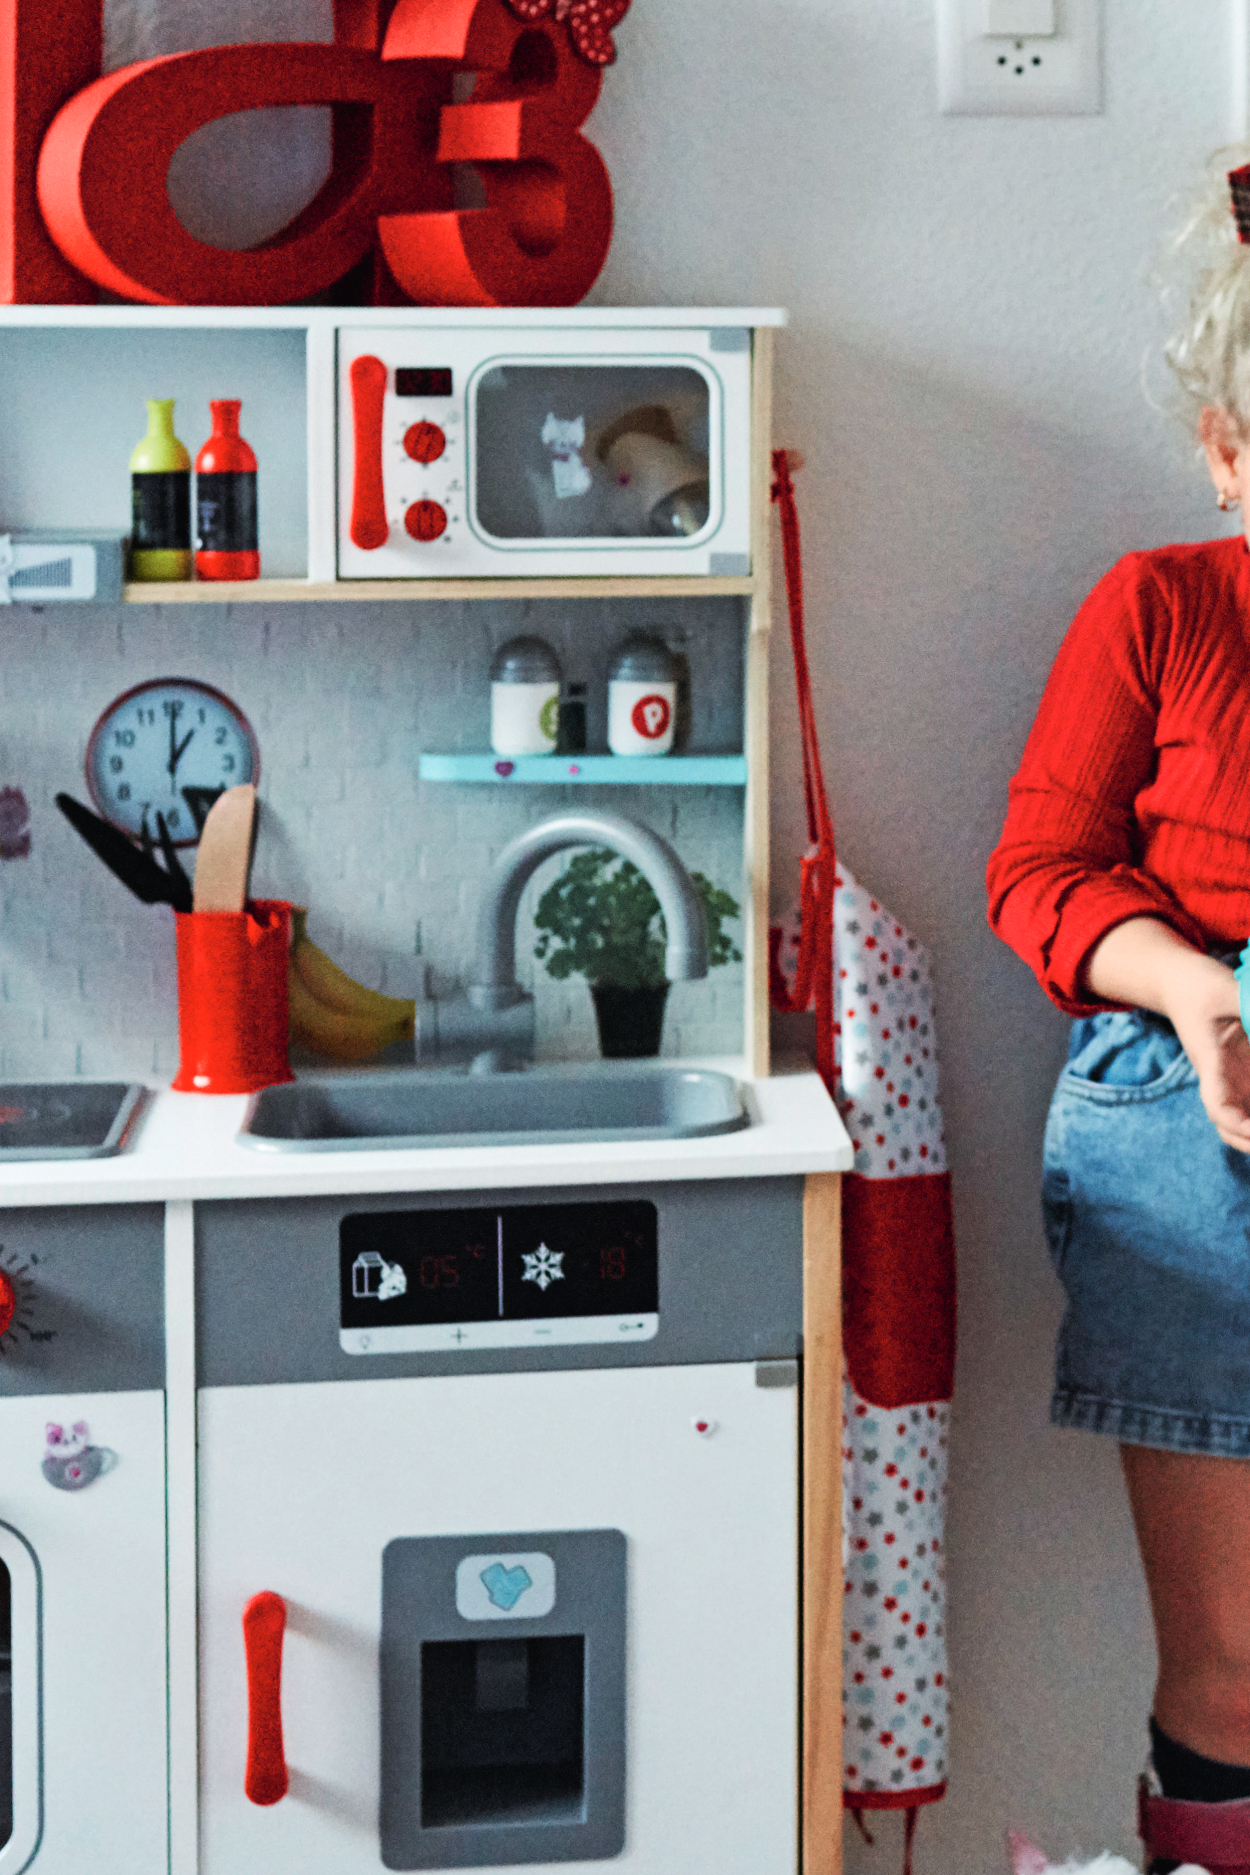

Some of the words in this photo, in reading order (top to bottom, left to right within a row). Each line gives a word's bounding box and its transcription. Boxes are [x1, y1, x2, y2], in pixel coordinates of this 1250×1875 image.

[137, 708, 155, 726] 11
[199, 708, 206, 725] 1
[643, 702, 663, 733] P
[115, 729, 136, 748] 10
[215, 726, 227, 745] 2
[110, 755, 123, 773] 9
[222, 753, 235, 773] 3
[118, 782, 131, 801] 8
